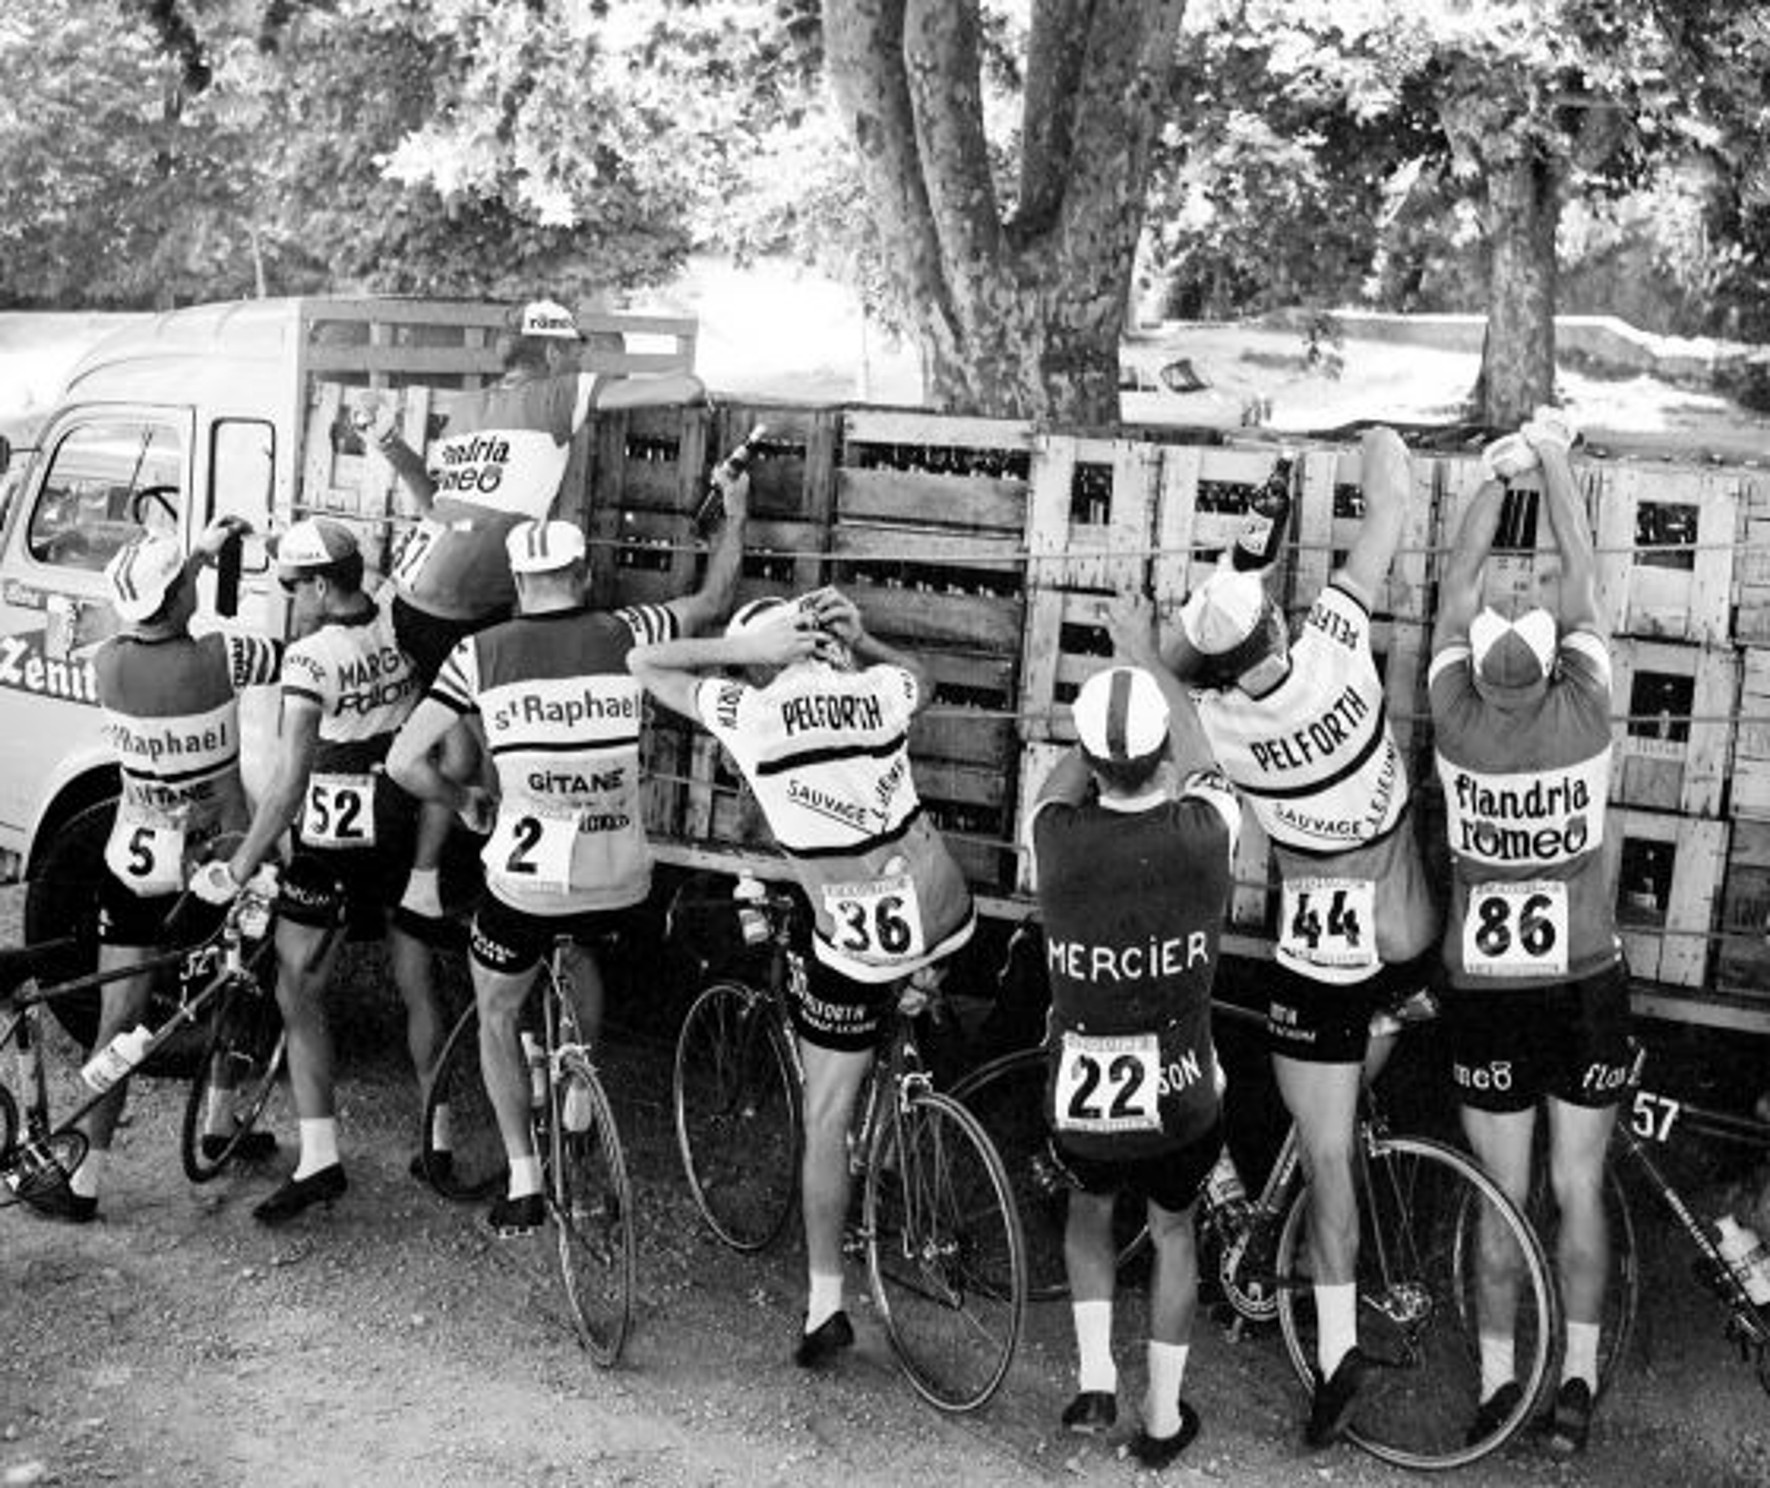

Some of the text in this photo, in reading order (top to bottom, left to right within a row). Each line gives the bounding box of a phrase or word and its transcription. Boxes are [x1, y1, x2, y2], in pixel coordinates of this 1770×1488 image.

[523, 688, 641, 728] Raphael
[782, 695, 884, 735] PELFORTH
[1250, 685, 1369, 772] PELFORTH
[311, 784, 364, 838] 52
[787, 779, 867, 824] SAUVAGE
[1455, 773, 1590, 819] flandria
[127, 827, 156, 877] 5
[506, 816, 543, 875] 2
[837, 896, 911, 954] 36
[1292, 890, 1360, 948] 44
[1475, 894, 1556, 957] 86
[1068, 1055, 1145, 1119] 22
[1633, 1091, 1680, 1141] 57
